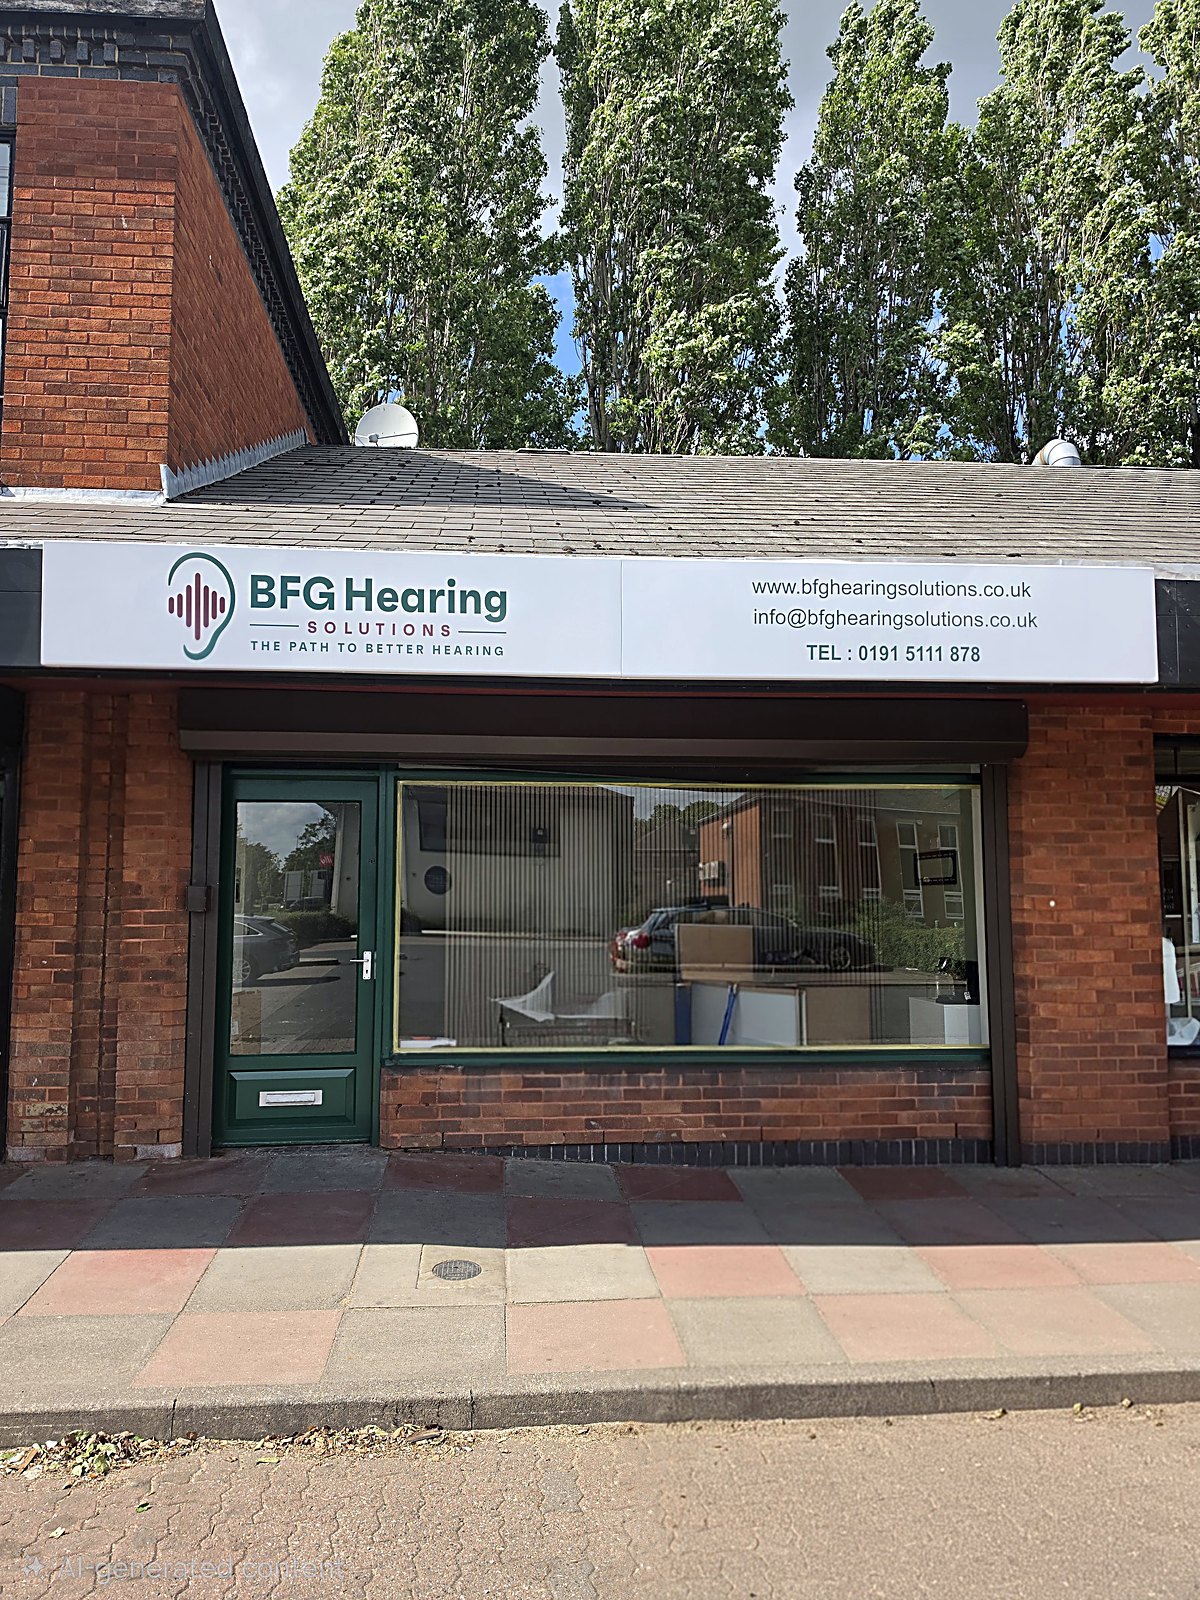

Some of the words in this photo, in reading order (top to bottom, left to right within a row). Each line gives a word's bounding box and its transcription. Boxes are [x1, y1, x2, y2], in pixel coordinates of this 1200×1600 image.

[250, 574, 335, 611] BFG
[346, 578, 507, 623] Hearing
[752, 578, 1032, 600] www.bfghearingsolutions.co.uk
[307, 620, 451, 637] SOLUTIONS
[753, 608, 1038, 631] info@bfghearingsolutions.co.uk
[251, 640, 281, 651] THE
[289, 641, 329, 653] PATH
[337, 642, 357, 653] TO
[366, 643, 425, 655] BETTER
[433, 644, 505, 657] HEARING
[806, 644, 841, 661] TEL
[858, 645, 899, 662] 0191
[905, 645, 943, 662] 5111
[950, 646, 981, 662] 878
